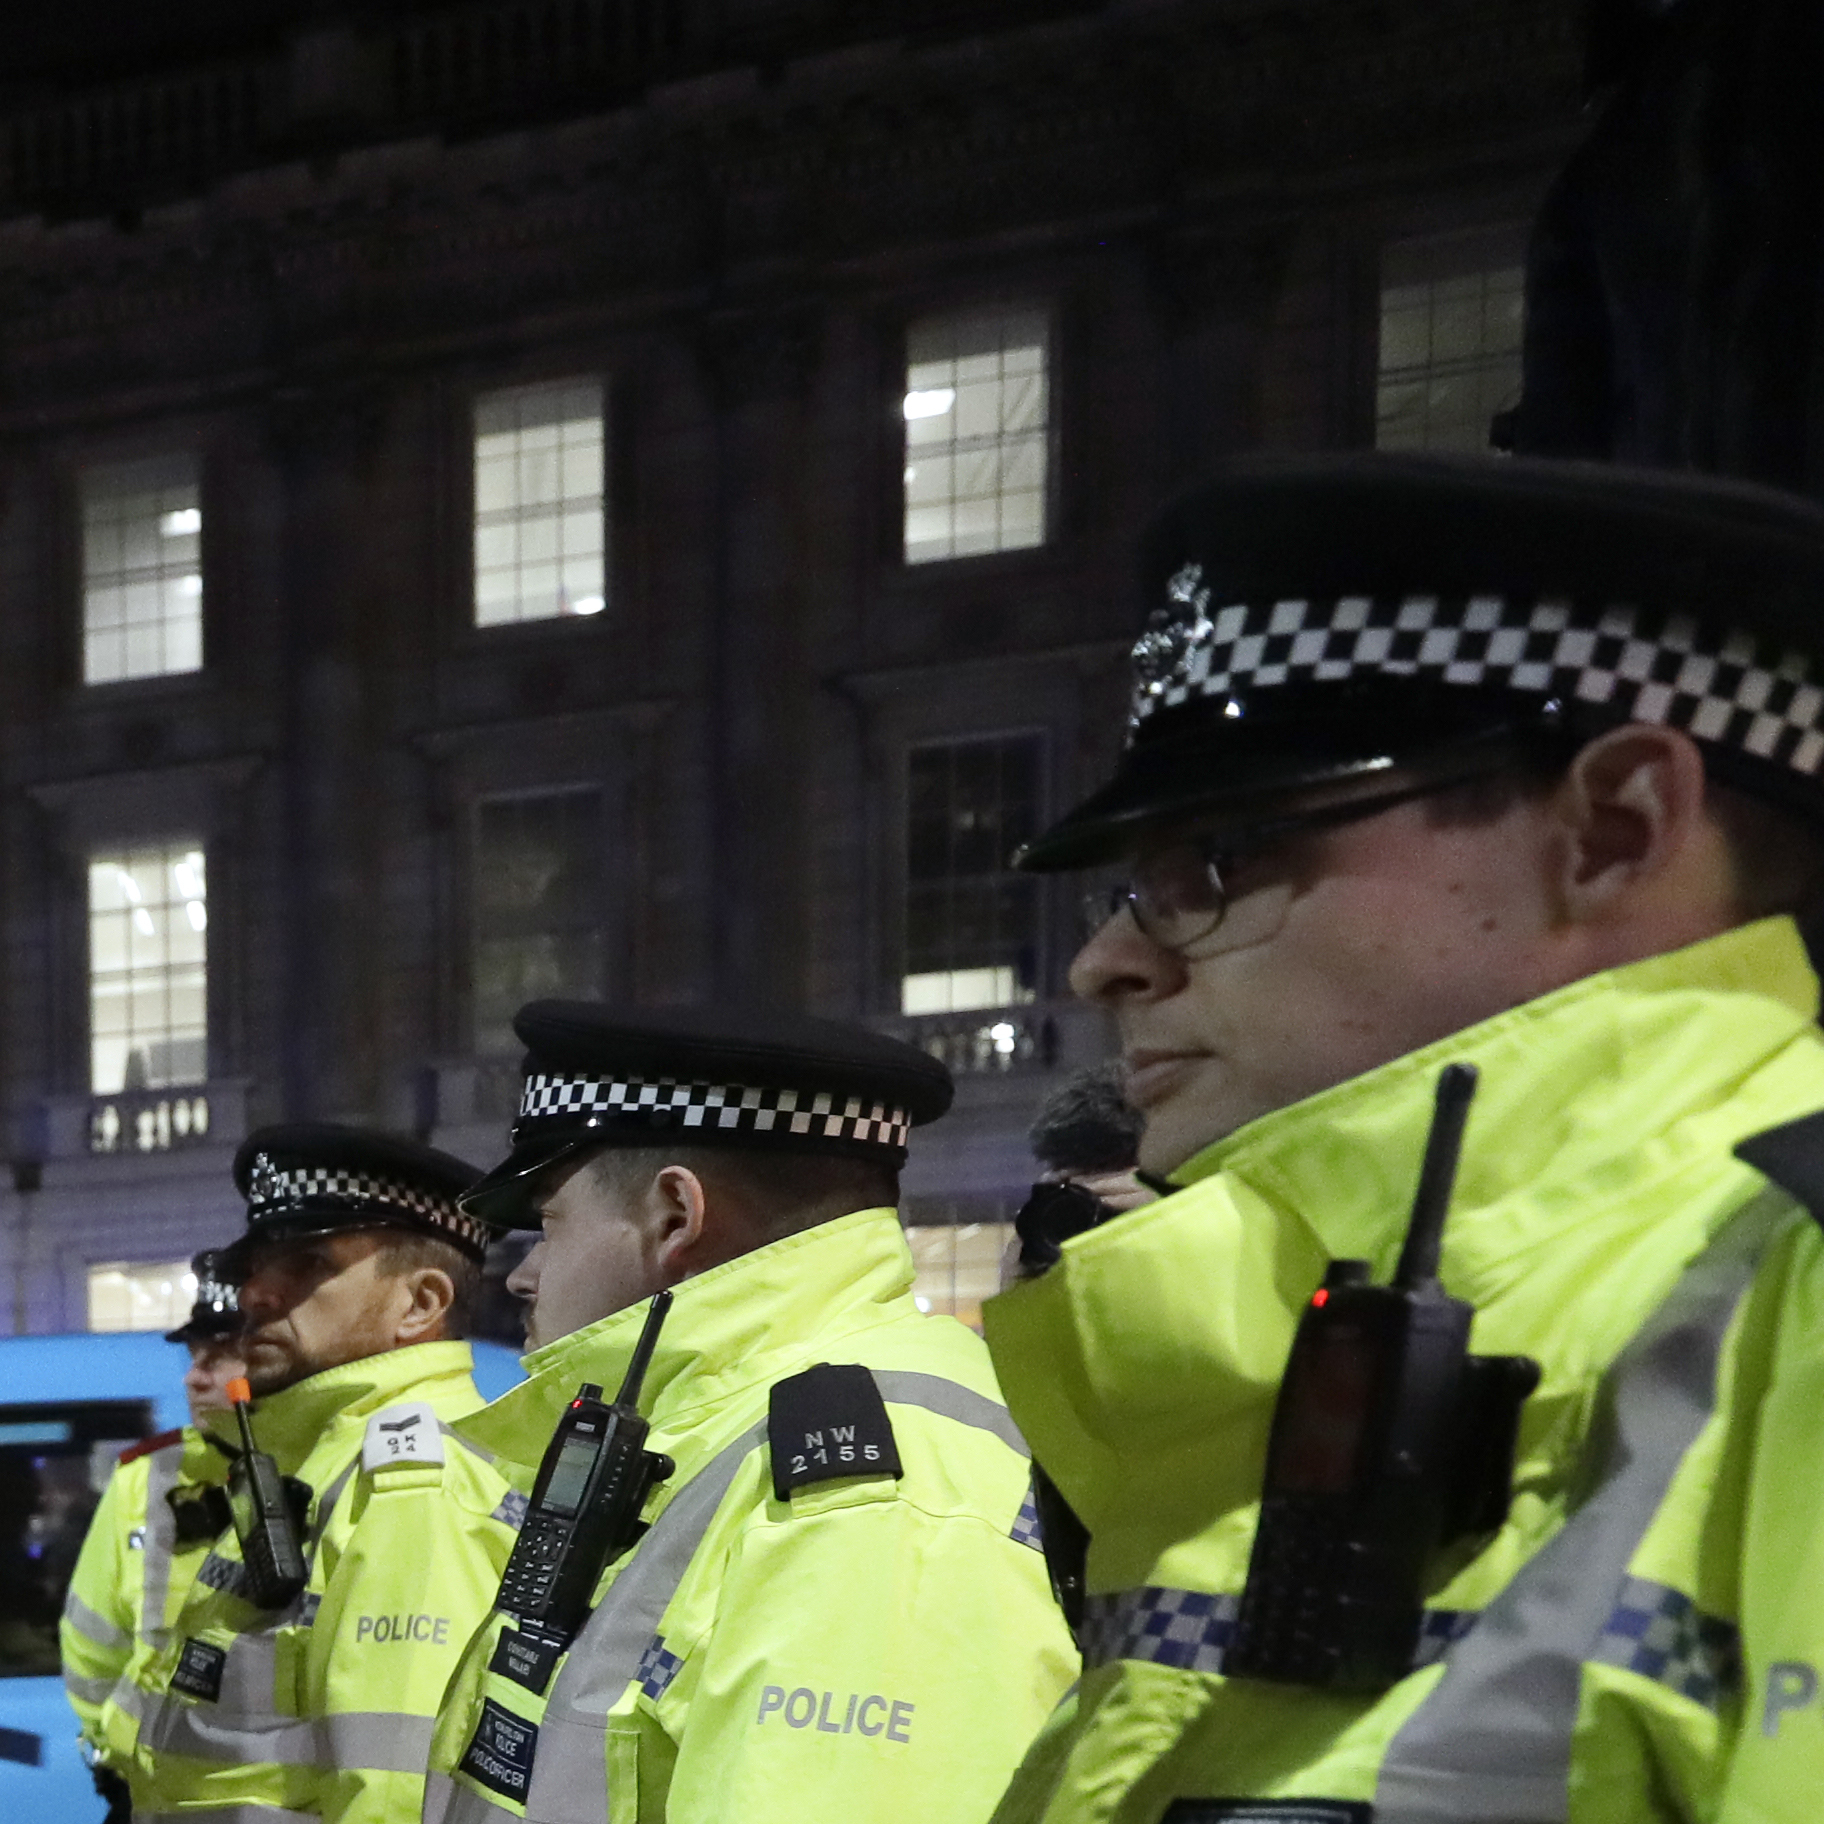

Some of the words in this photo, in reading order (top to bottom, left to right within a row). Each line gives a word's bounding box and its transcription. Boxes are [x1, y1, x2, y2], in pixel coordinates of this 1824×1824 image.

[791, 1445, 880, 1474] 2155
[356, 1614, 450, 1645] POLICE
[757, 1683, 915, 1744] POLICE
